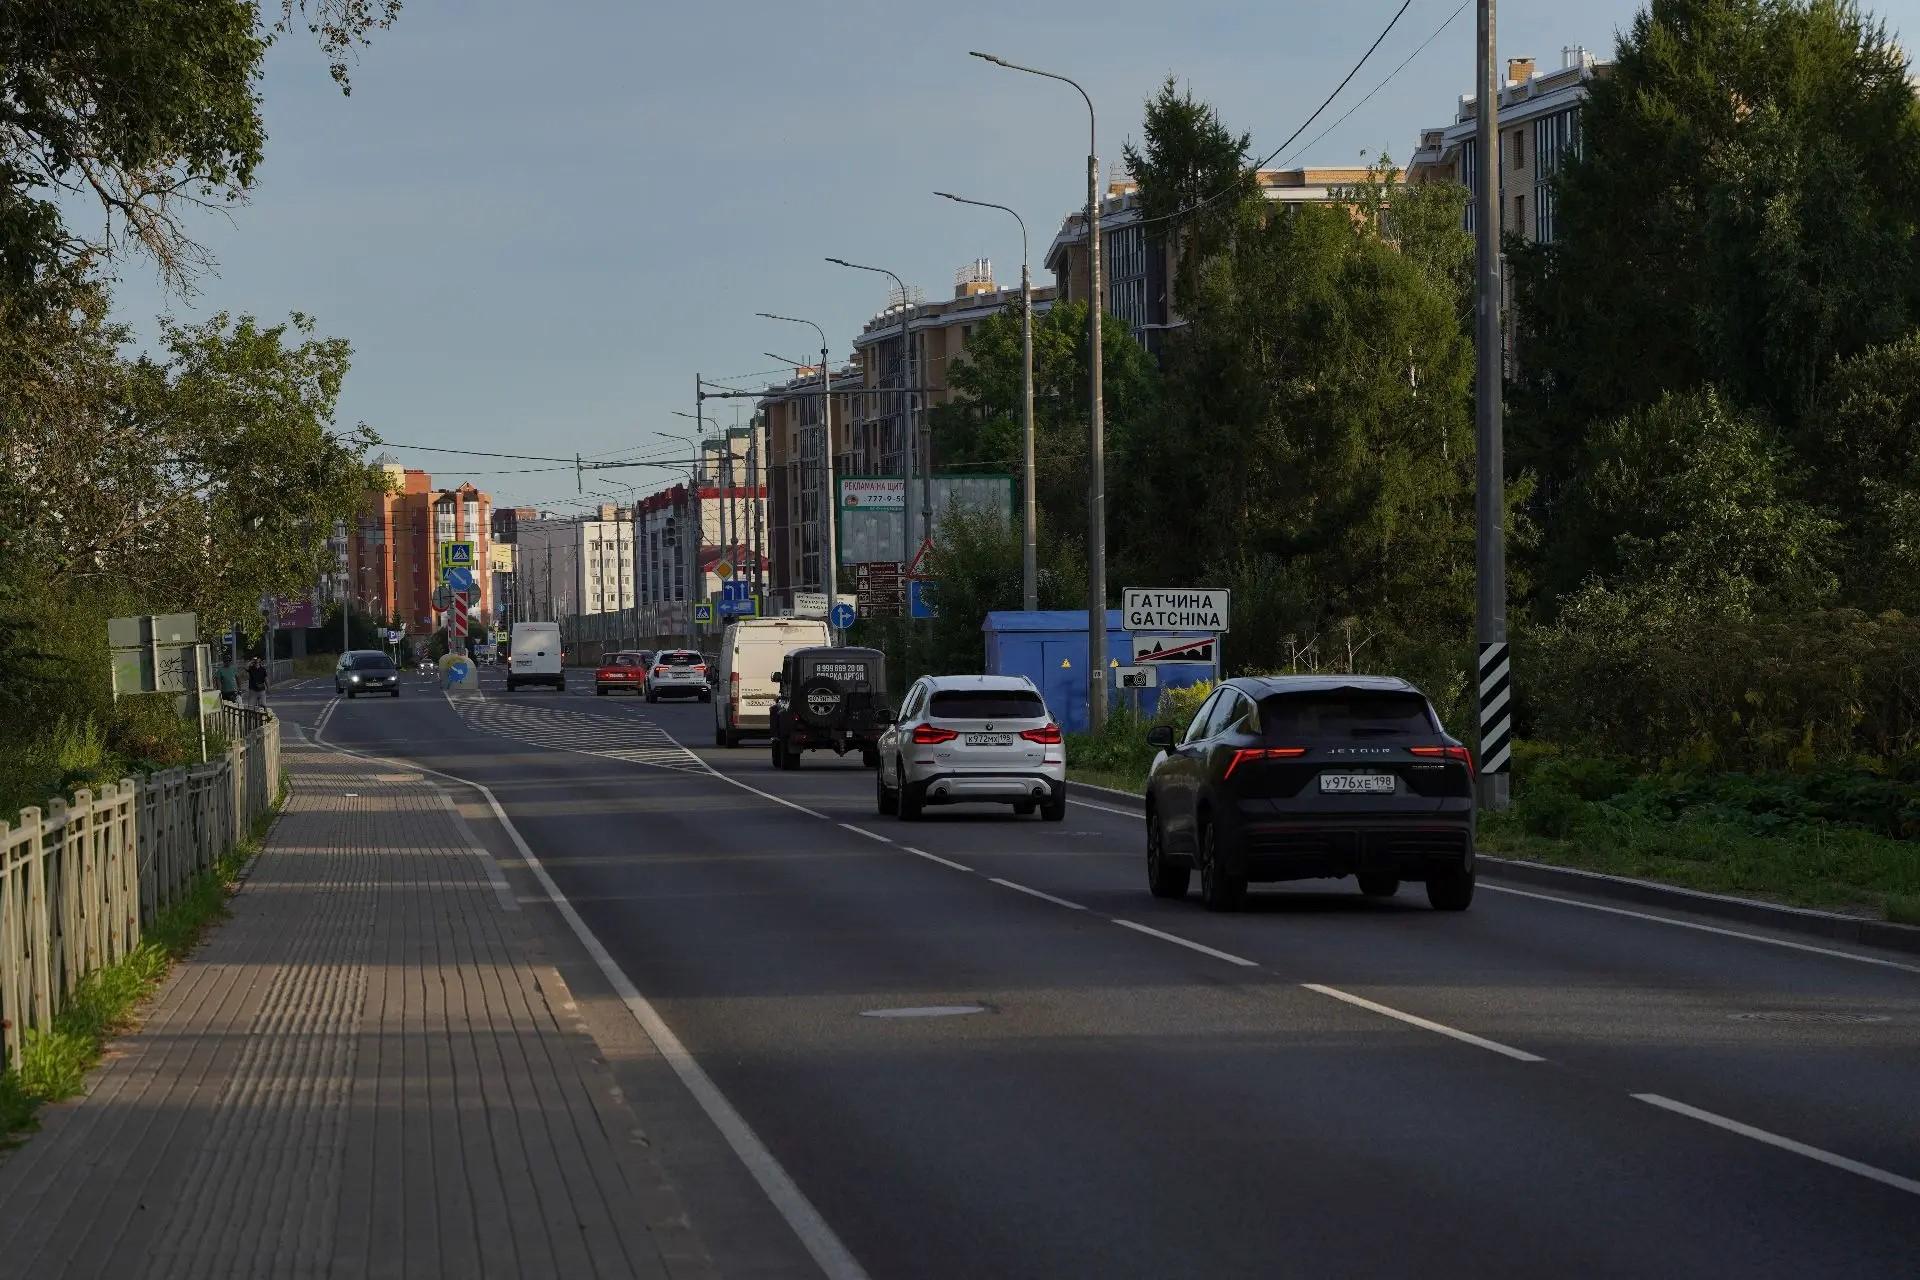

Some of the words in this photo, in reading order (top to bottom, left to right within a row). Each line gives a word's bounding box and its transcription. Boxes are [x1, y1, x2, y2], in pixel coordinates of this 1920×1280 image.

[844, 481, 875, 491] РЕКЛАМА
[876, 482, 886, 491] НА
[1130, 594, 1214, 609] ГАТЧИНА
[1130, 611, 1221, 627] GATCHINA
[816, 664, 821, 672] 8
[821, 664, 834, 672] 999
[1325, 777, 1371, 789] У976ХЕ
[1375, 777, 1391, 786] 198
